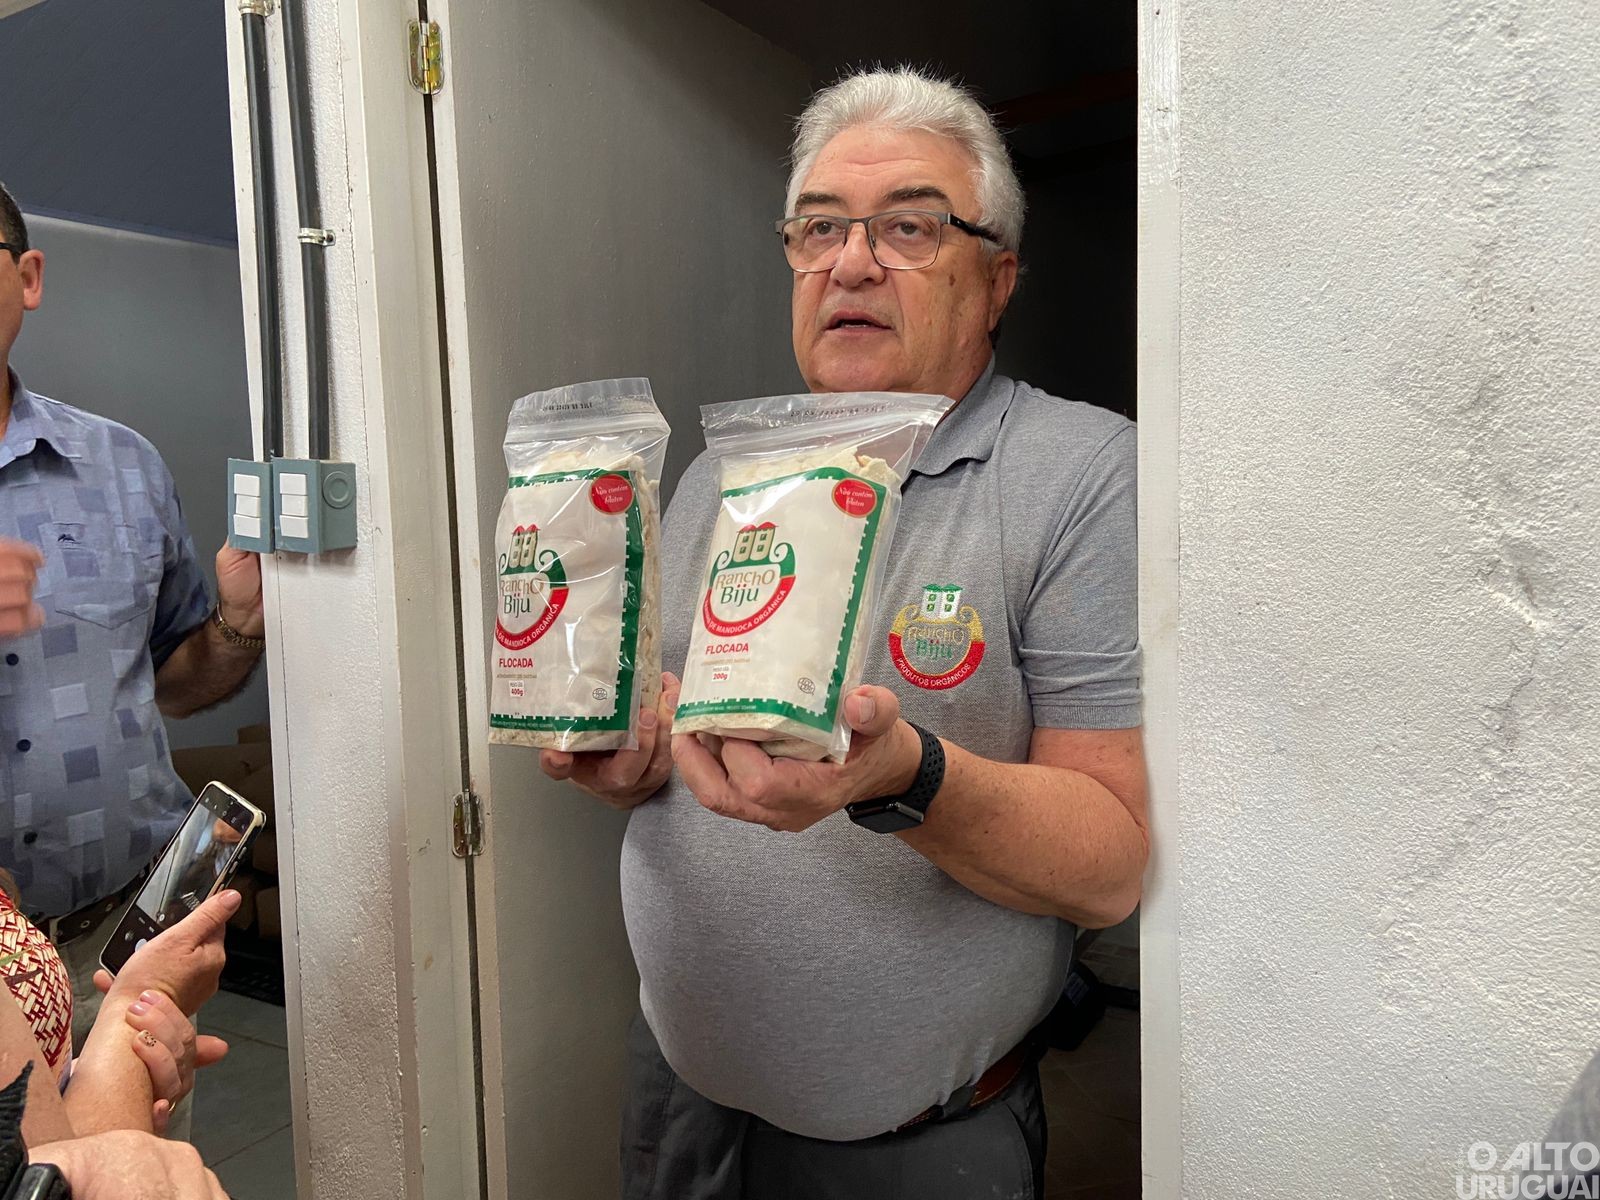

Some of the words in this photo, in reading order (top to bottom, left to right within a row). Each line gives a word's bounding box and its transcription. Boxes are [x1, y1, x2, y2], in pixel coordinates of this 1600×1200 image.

[720, 583, 760, 607] Biju
[503, 593, 531, 618] Biju
[715, 621, 753, 634] MANDIOCA
[705, 642, 750, 655] FLOCADA
[915, 639, 952, 660] Biju
[498, 657, 534, 668] FLOCADA
[712, 672, 728, 680] 200g
[896, 658, 929, 686] PRODUTOS
[511, 688, 524, 697] 400g
